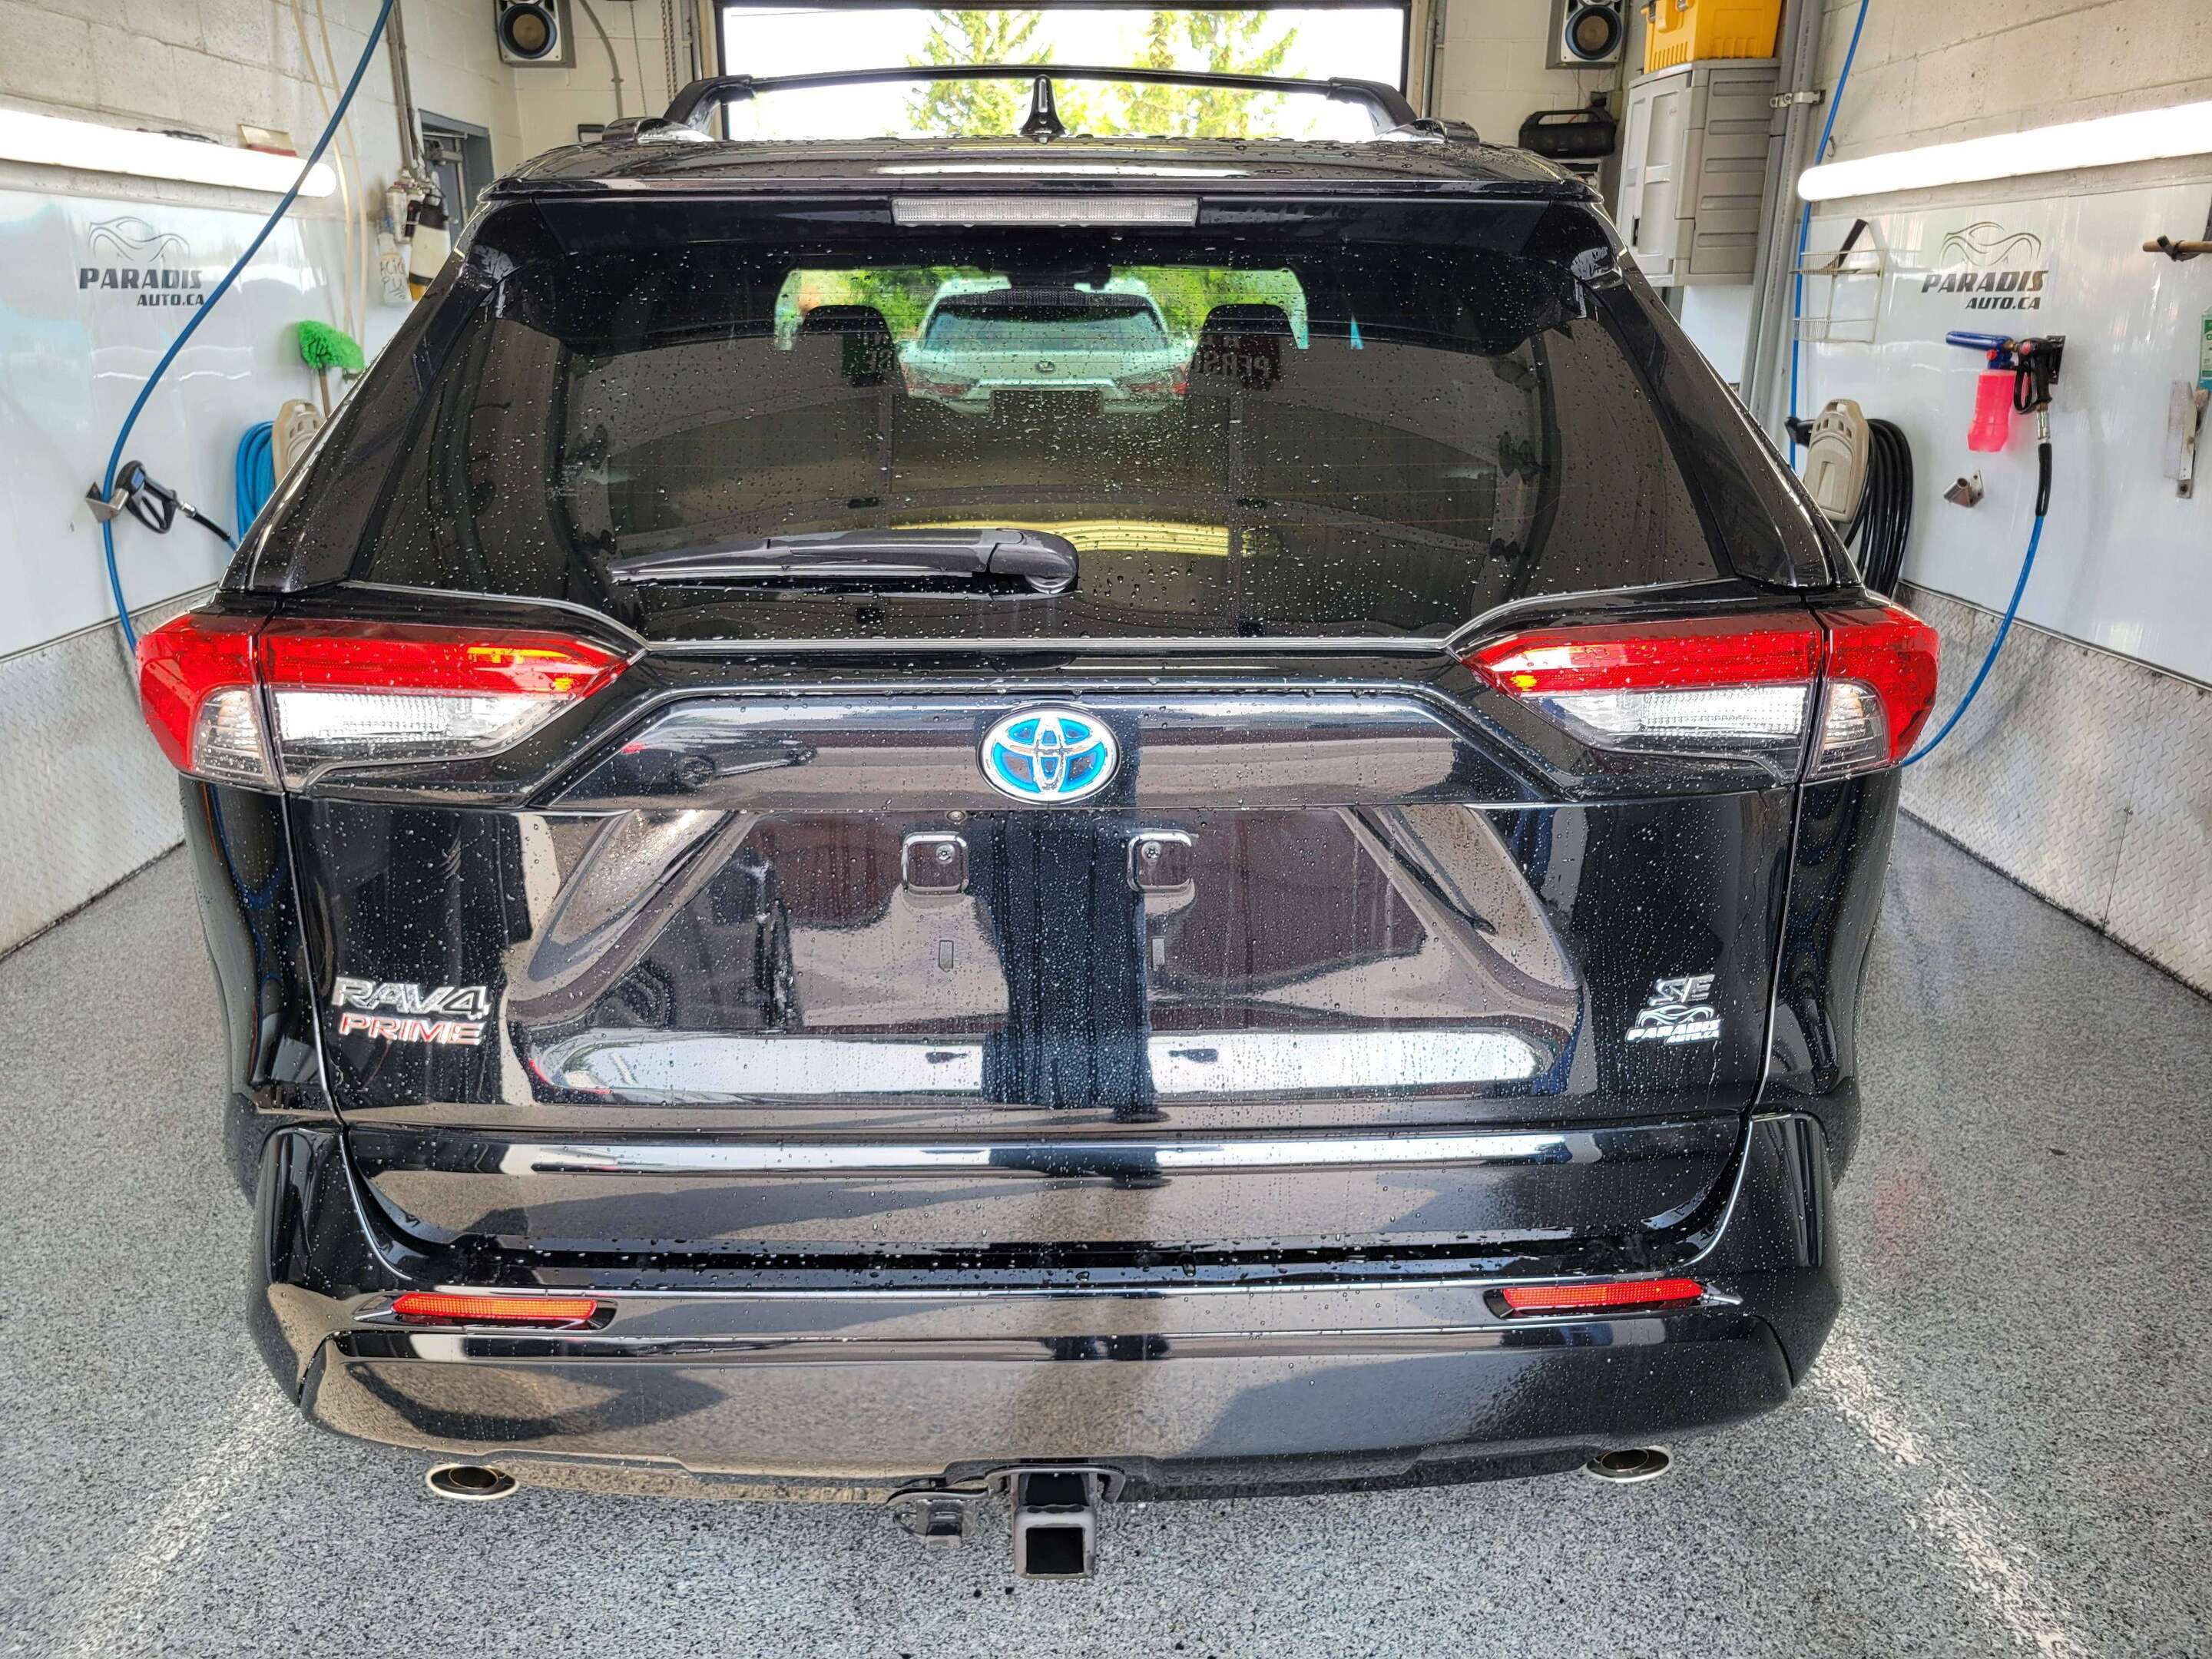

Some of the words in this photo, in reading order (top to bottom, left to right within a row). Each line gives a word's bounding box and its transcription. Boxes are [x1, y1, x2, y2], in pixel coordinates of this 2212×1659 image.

[79, 267, 203, 290] PARADIS
[1921, 270, 2049, 293] PARADIS
[137, 293, 204, 306] AUTO.CA
[1965, 296, 2041, 310] AUTO.CA
[330, 976, 492, 1020] RAV4
[1647, 973, 1715, 1006] SE
[339, 1012, 488, 1046] PRIME
[1625, 1019, 1721, 1041] PARADIS
